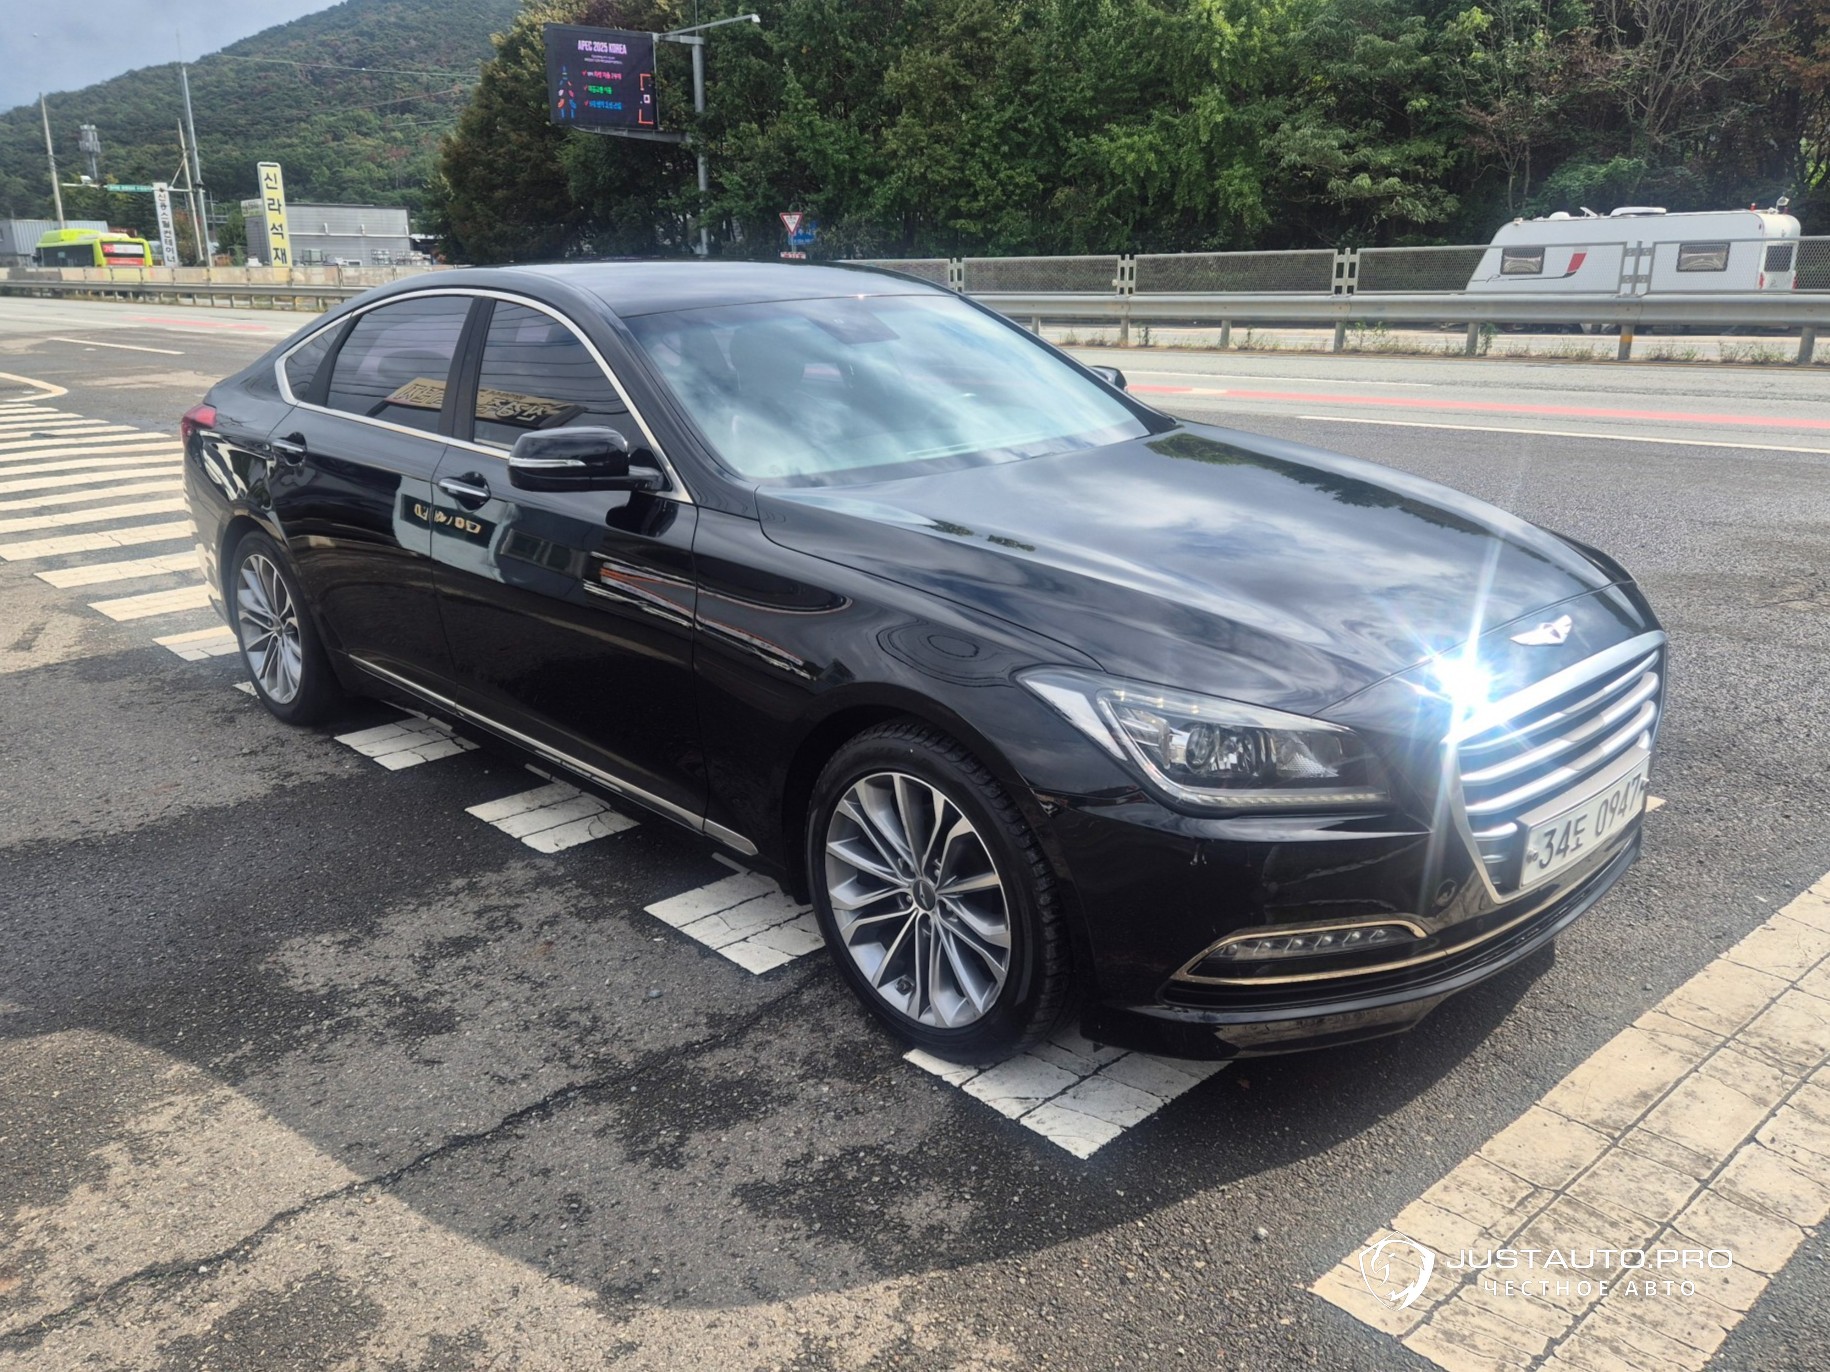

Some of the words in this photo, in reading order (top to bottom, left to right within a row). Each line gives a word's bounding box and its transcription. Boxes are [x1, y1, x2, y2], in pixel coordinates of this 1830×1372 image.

[578, 40, 592, 51] APEC
[593, 41, 608, 53] 2025
[608, 43, 627, 55] KOREA
[264, 172, 287, 264] 신라석재
[1539, 813, 1588, 869] 34도
[1594, 773, 1642, 837] 0947
